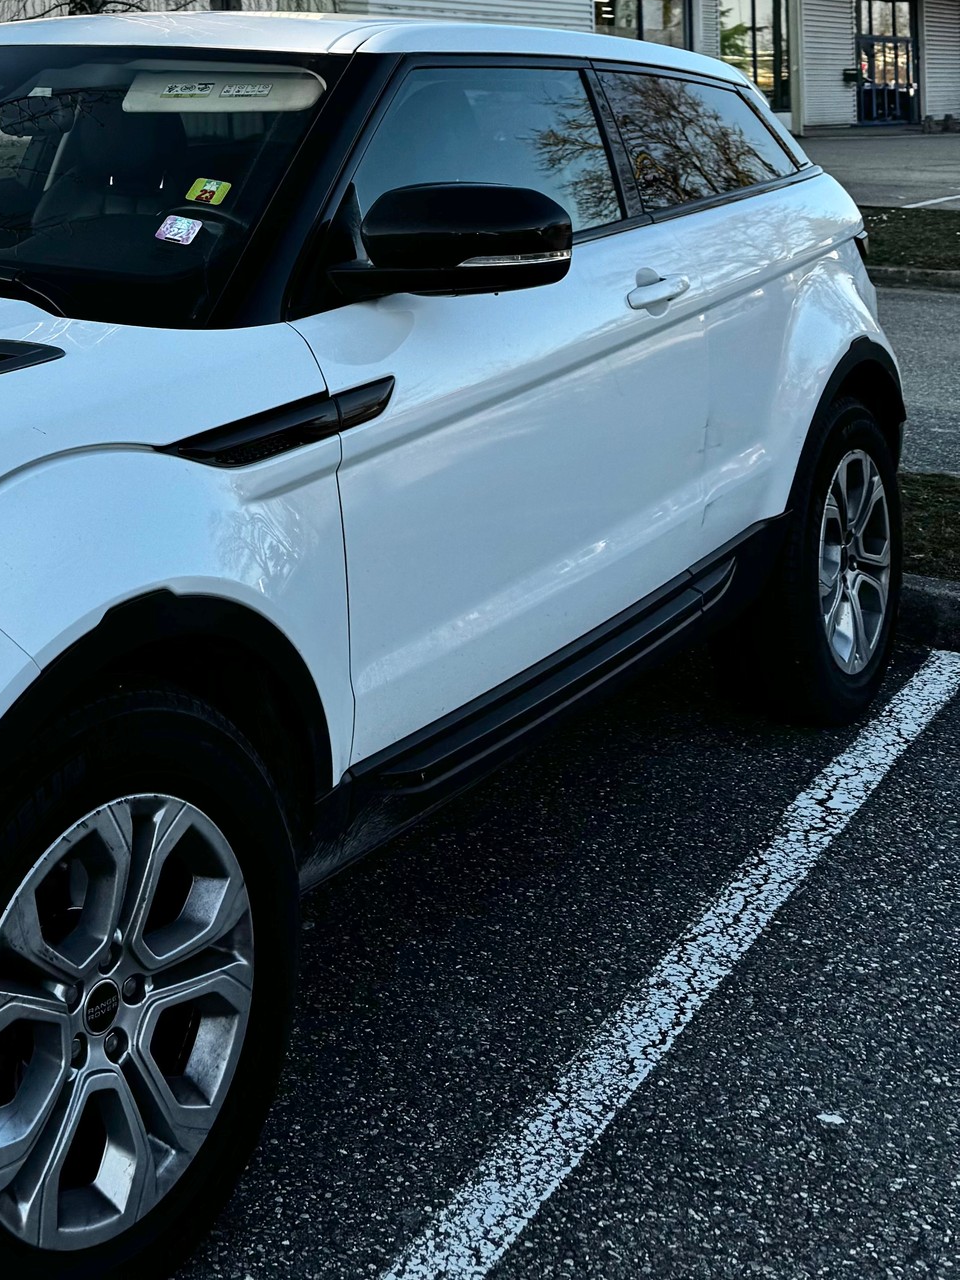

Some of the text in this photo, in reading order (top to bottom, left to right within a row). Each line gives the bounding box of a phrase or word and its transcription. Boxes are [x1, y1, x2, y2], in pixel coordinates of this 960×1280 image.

[195, 189, 216, 203] 23
[88, 995, 117, 1015] RANGE
[88, 1001, 118, 1021] ROVER
